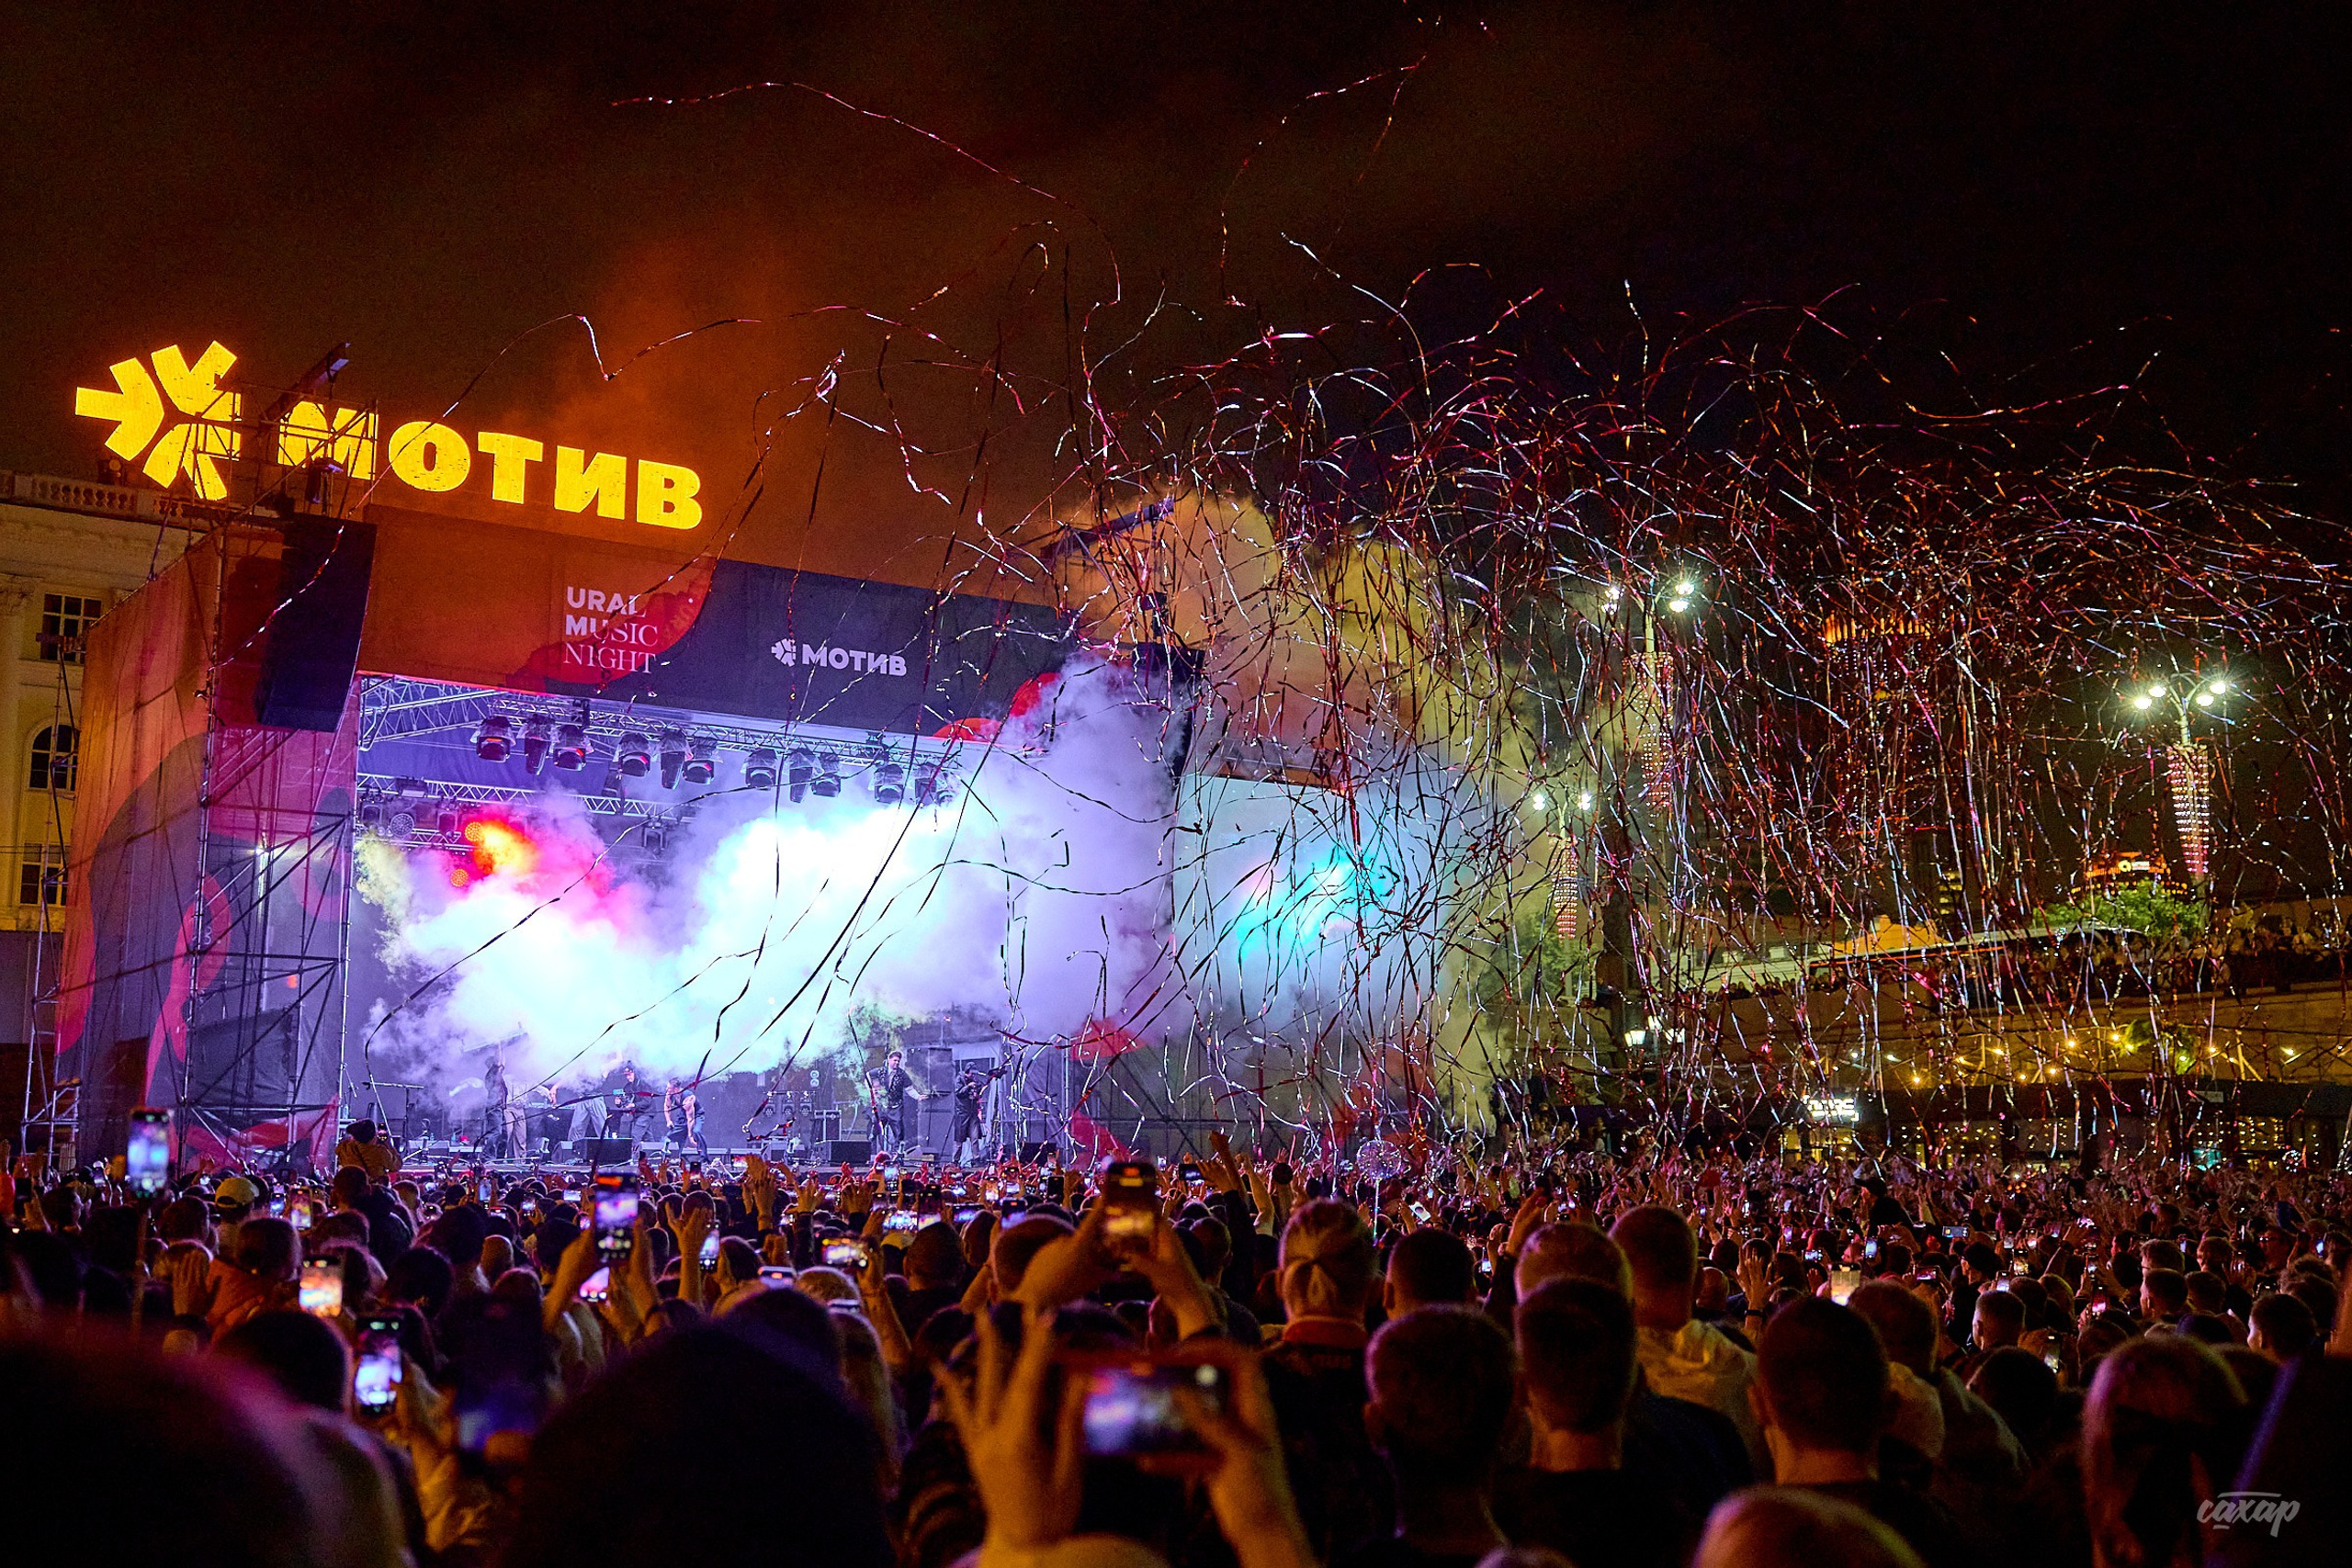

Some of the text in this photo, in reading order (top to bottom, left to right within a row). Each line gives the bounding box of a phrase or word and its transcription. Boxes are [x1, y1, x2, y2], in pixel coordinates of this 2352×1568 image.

[277, 400, 703, 530] МОТИВ
[567, 586, 647, 617] URAL
[565, 614, 658, 647] MUSIC
[563, 642, 657, 674] NIGHT
[802, 643, 907, 677] МОТИВ
